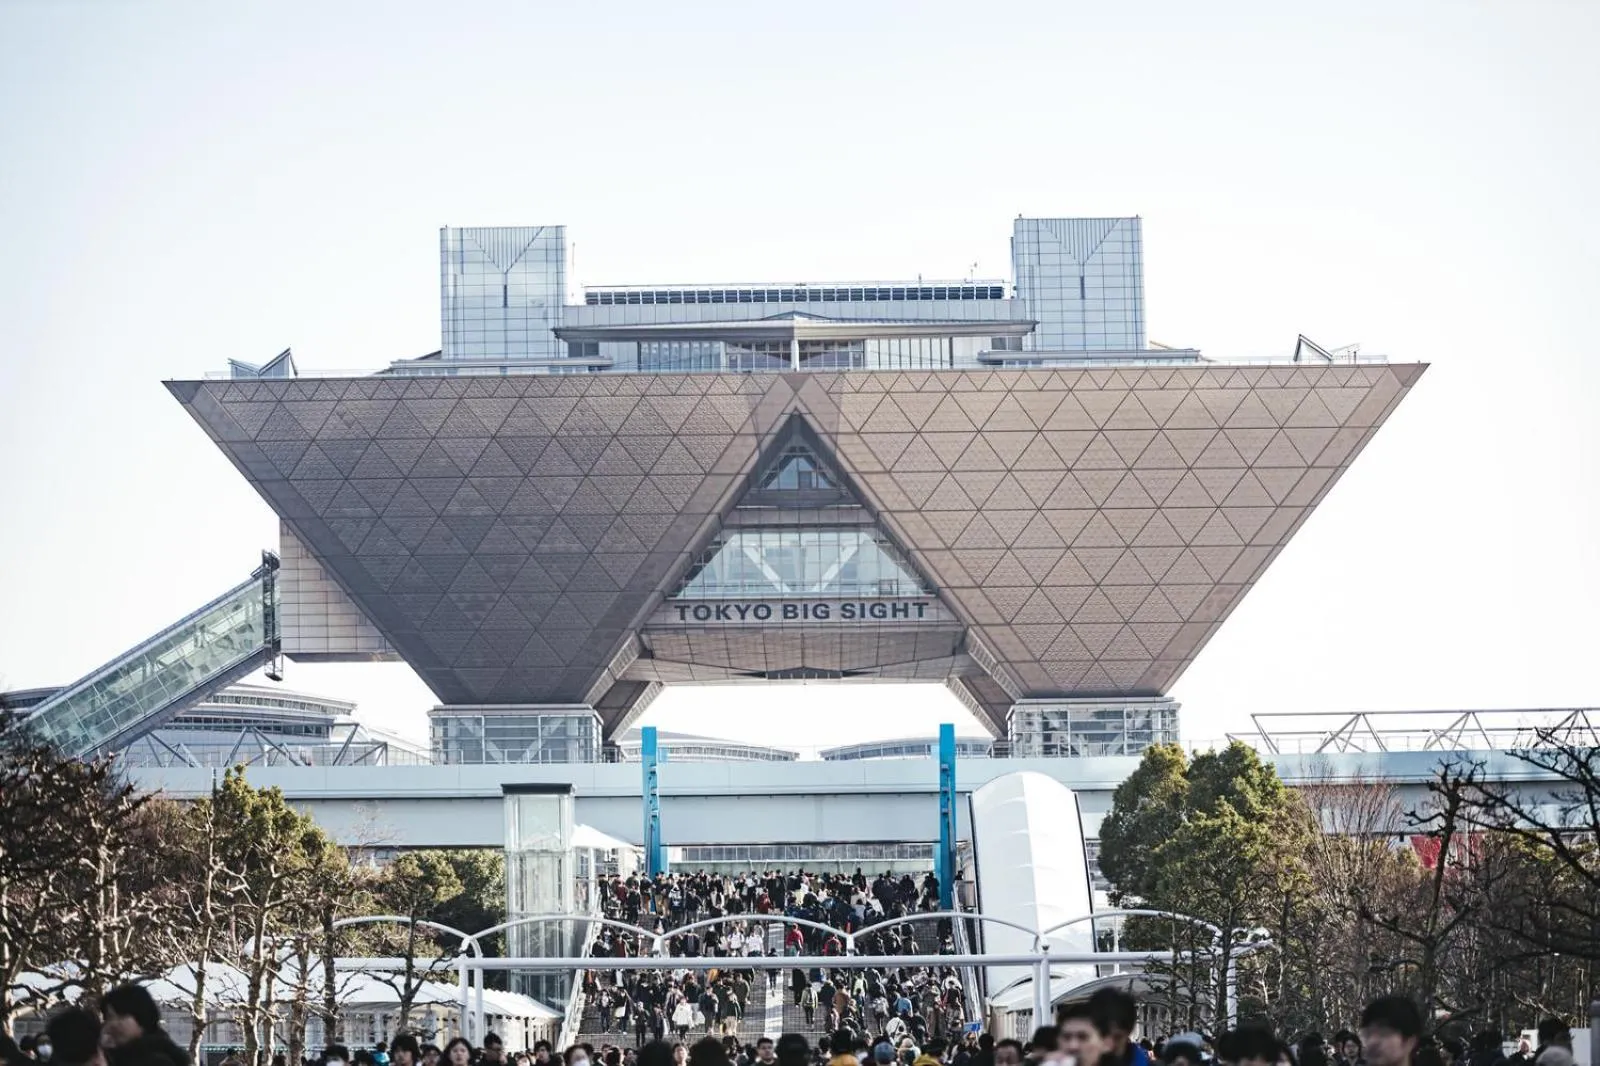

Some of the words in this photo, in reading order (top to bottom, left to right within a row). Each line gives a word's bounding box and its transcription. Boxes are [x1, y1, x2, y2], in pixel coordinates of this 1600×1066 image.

[674, 604, 772, 621] TOKYO
[783, 603, 830, 620] BIG
[840, 602, 929, 619] SIGHT
